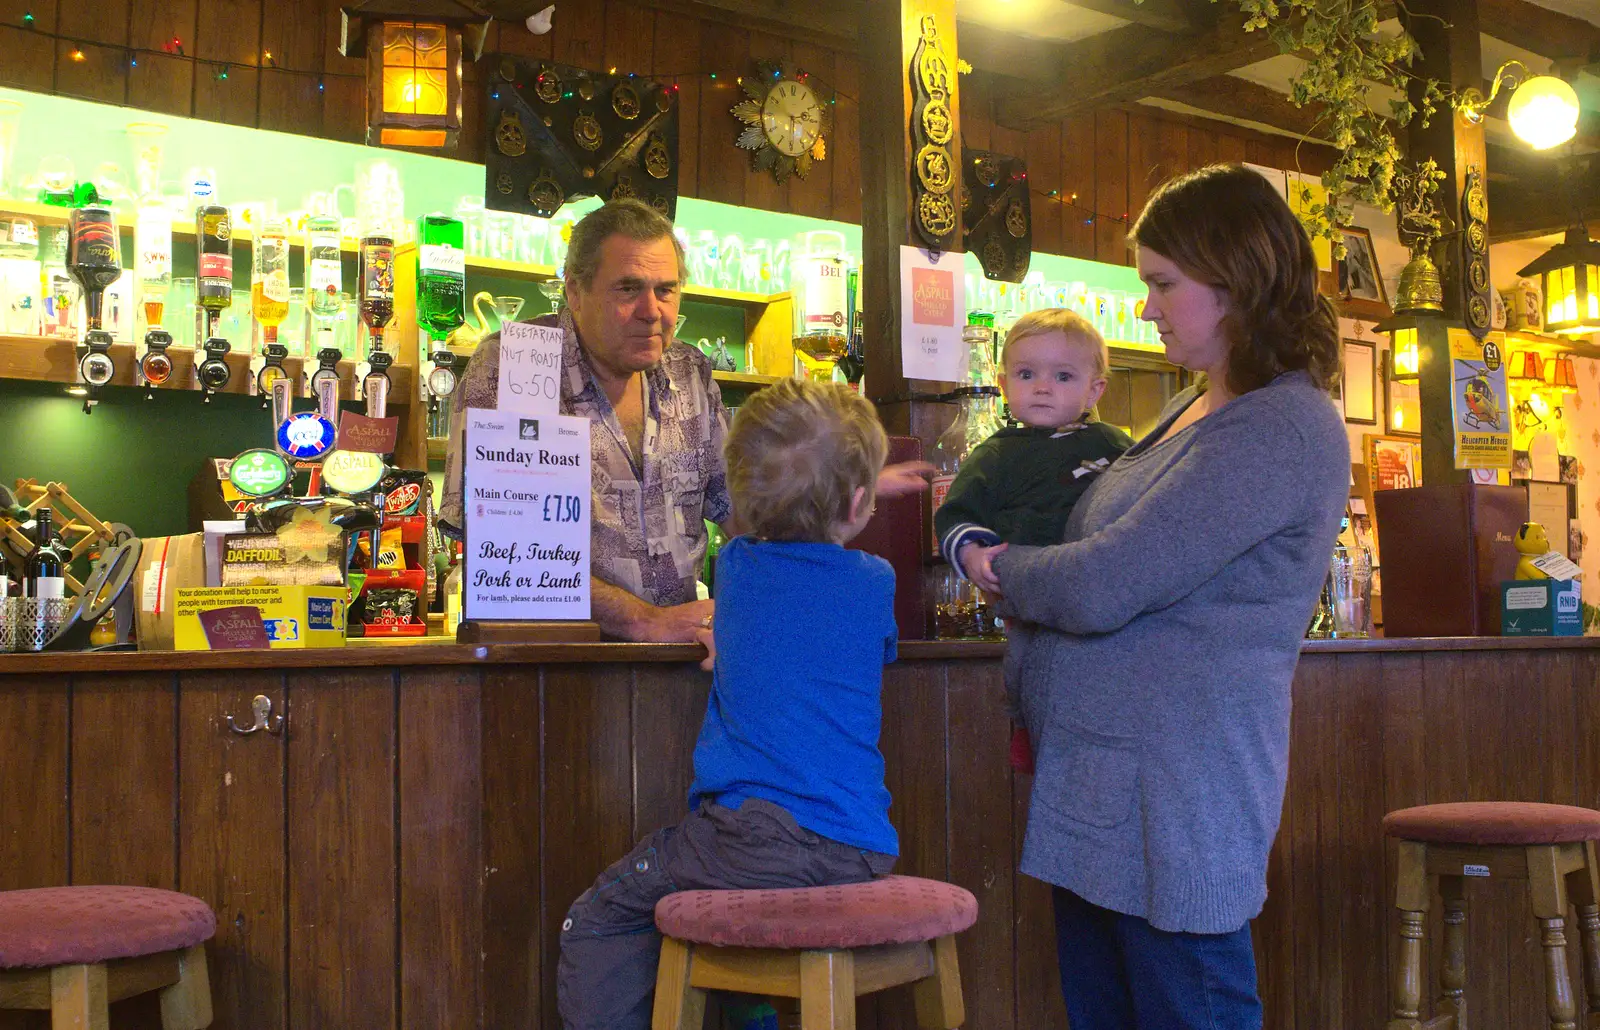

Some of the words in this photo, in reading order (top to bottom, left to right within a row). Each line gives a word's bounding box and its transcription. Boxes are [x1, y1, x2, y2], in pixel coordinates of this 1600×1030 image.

[915, 284, 952, 302] ASPALL
[502, 321, 561, 343] VEGETARIAN
[502, 345, 524, 363] NUT
[530, 348, 562, 370] ROAST
[1486, 344, 1497, 358] £1
[346, 424, 392, 438] ASPALL
[473, 421, 486, 429] The
[487, 422, 505, 431] Swan
[475, 445, 533, 467] Sunday
[538, 449, 581, 467] Roast
[1394, 473, 1409, 489] 18
[474, 487, 501, 499] Main
[503, 489, 539, 501] Course
[543, 494, 581, 523] £7.50
[227, 549, 281, 562] DAFFODIL
[479, 541, 521, 564] Beef,
[526, 543, 581, 566] Turkey
[473, 568, 512, 587] Pork
[516, 576, 533, 588] or
[537, 570, 582, 588] Lamb
[177, 589, 193, 598] Your
[193, 588, 223, 597] donation
[224, 587, 235, 596] will
[235, 587, 251, 597] help
[251, 587, 259, 595] to
[259, 587, 279, 595] nurse
[490, 594, 510, 602] lamb,
[510, 595, 531, 603] please
[532, 595, 545, 603] add
[177, 599, 200, 608] people
[200, 597, 216, 606] with
[216, 597, 245, 606] terminal
[245, 597, 269, 605] cancer
[269, 596, 282, 604] and
[1559, 596, 1577, 608] RNIB
[177, 608, 196, 617] other
[212, 619, 260, 635] ASPALL
